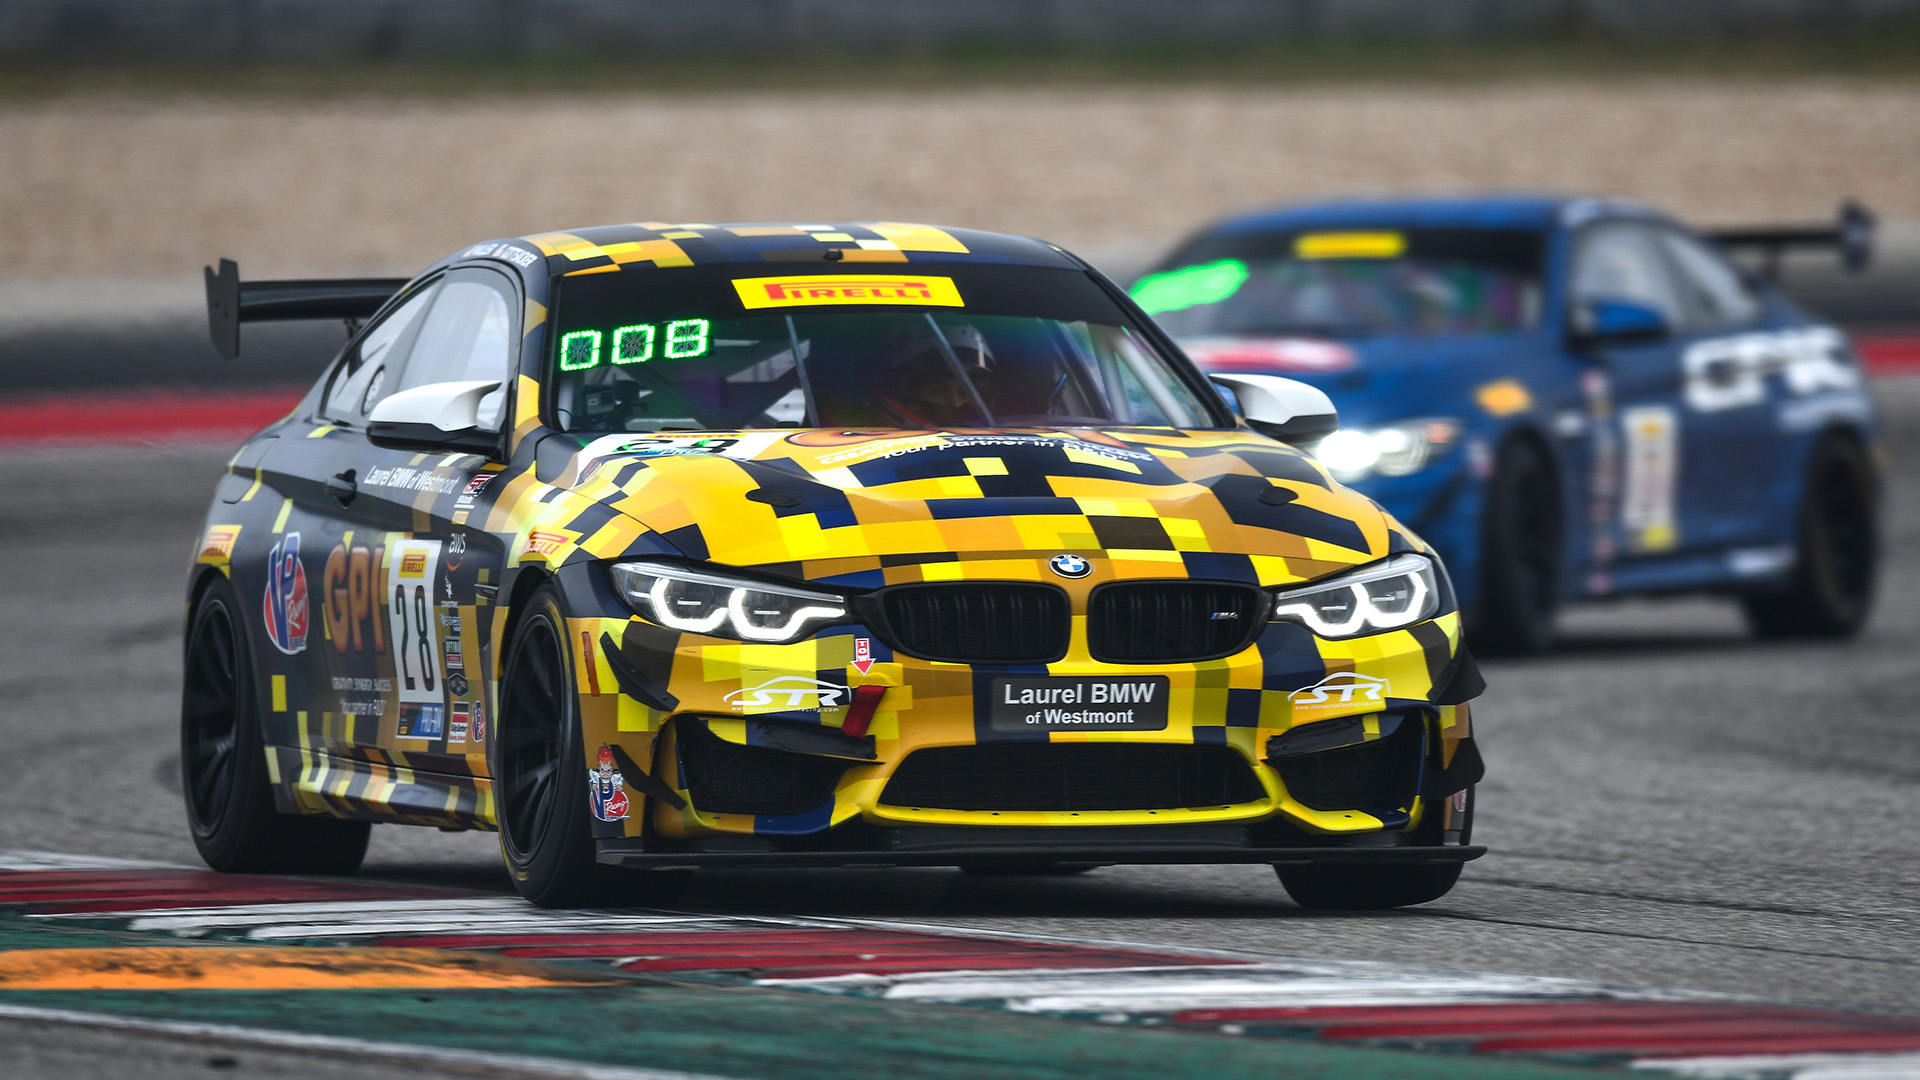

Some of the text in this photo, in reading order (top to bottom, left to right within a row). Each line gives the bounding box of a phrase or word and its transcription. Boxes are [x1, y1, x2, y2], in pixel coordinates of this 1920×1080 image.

[763, 280, 933, 300] PIRELLI
[1033, 439, 1056, 448] in
[363, 465, 396, 487] Laurel
[387, 467, 417, 489] BMW
[413, 470, 461, 495] Westmont
[448, 532, 466, 554] aws
[401, 554, 426, 573] PIRELLI
[395, 583, 436, 692] 28
[857, 640, 869, 662] TOW
[731, 689, 844, 706] STR
[1004, 682, 1156, 704] Laurel BMW
[1294, 683, 1384, 704] STR
[1025, 708, 1134, 724] of Westmont
